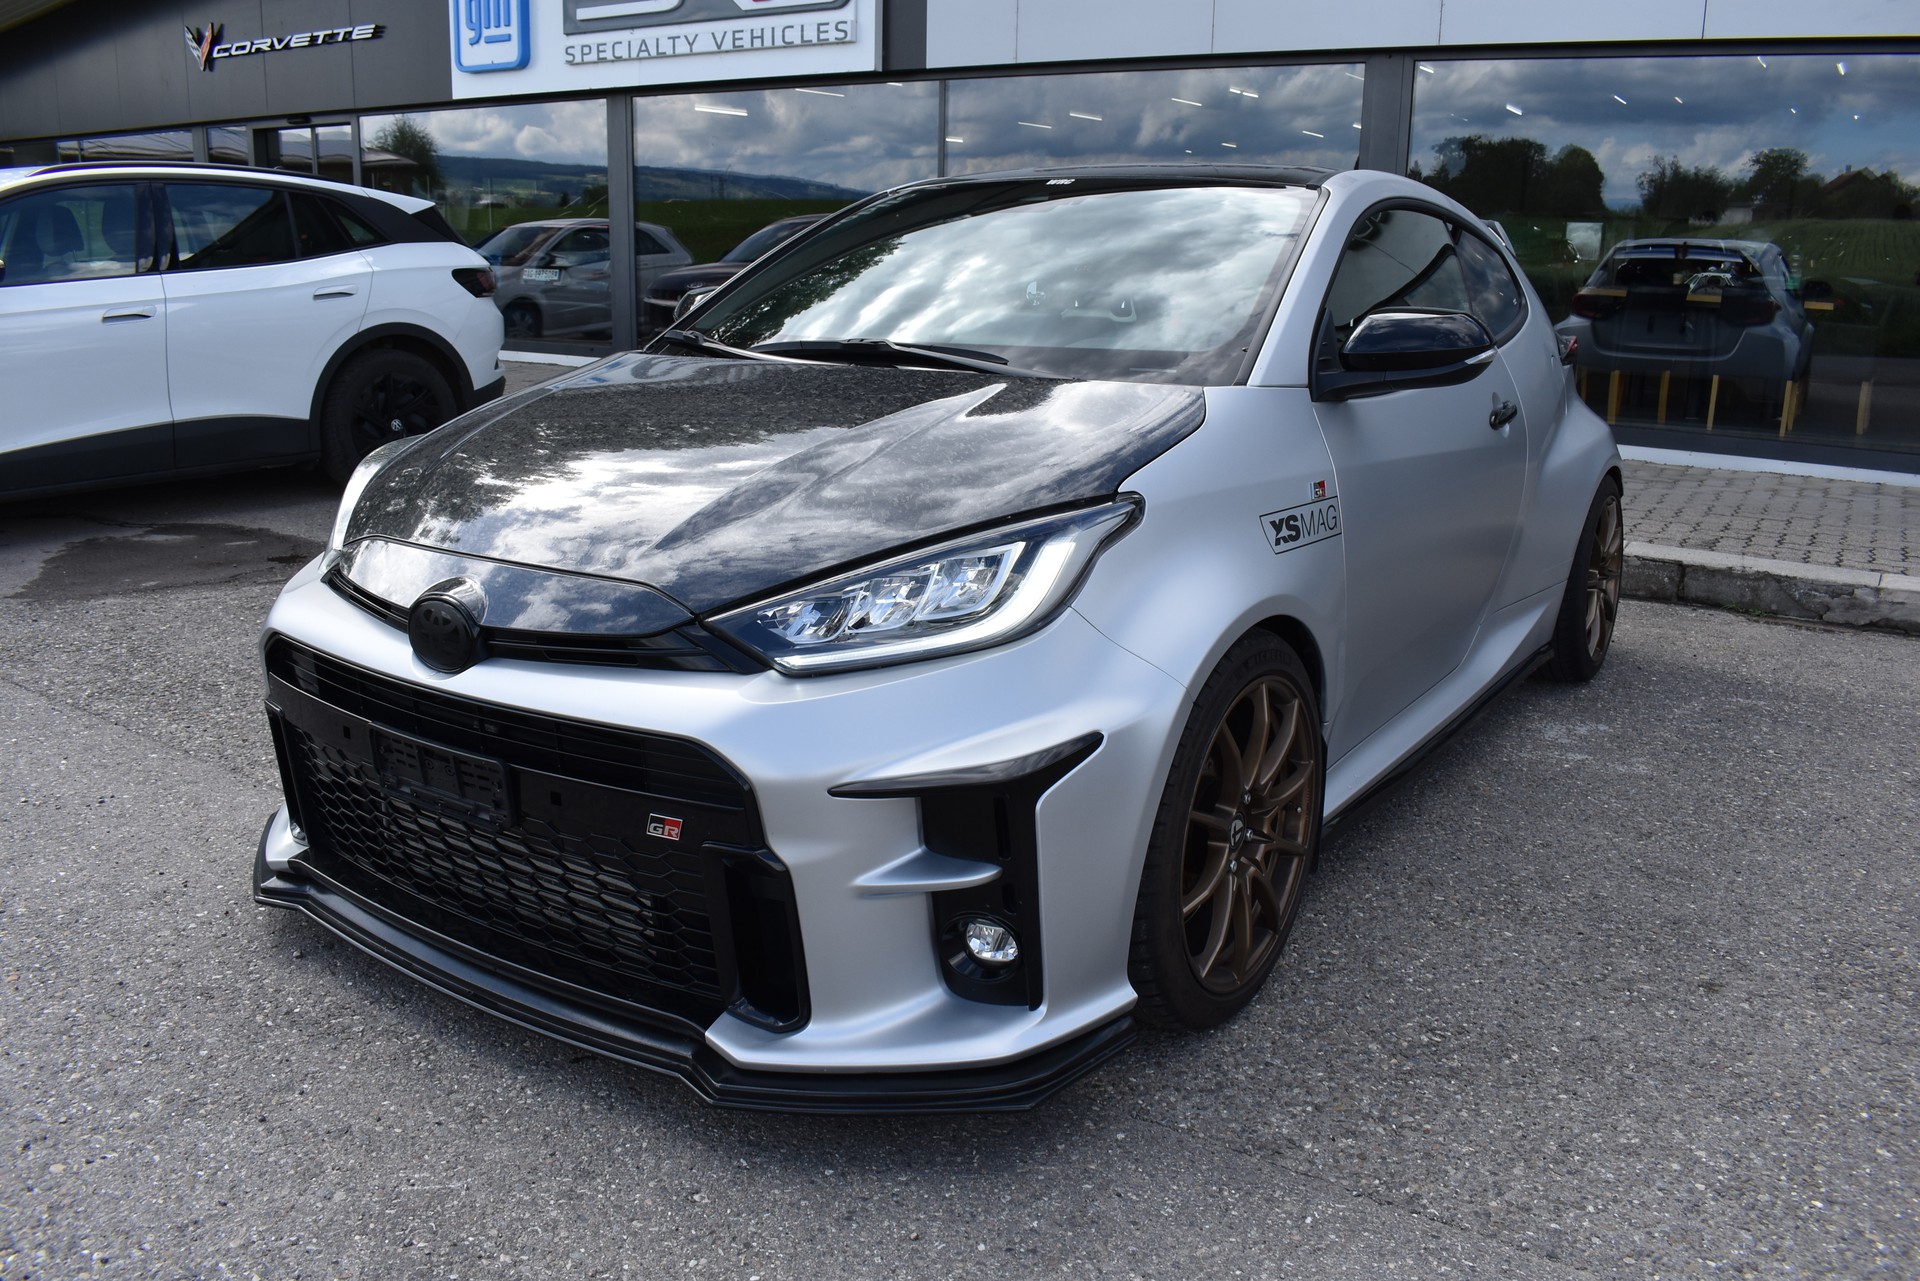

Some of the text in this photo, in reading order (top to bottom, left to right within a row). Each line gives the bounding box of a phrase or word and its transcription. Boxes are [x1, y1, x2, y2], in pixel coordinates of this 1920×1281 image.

[213, 24, 376, 58] CORVETTE
[565, 20, 848, 64] SPECIALTY VEHICLES
[1269, 504, 1338, 547] XSMAG
[649, 822, 679, 838] GR
